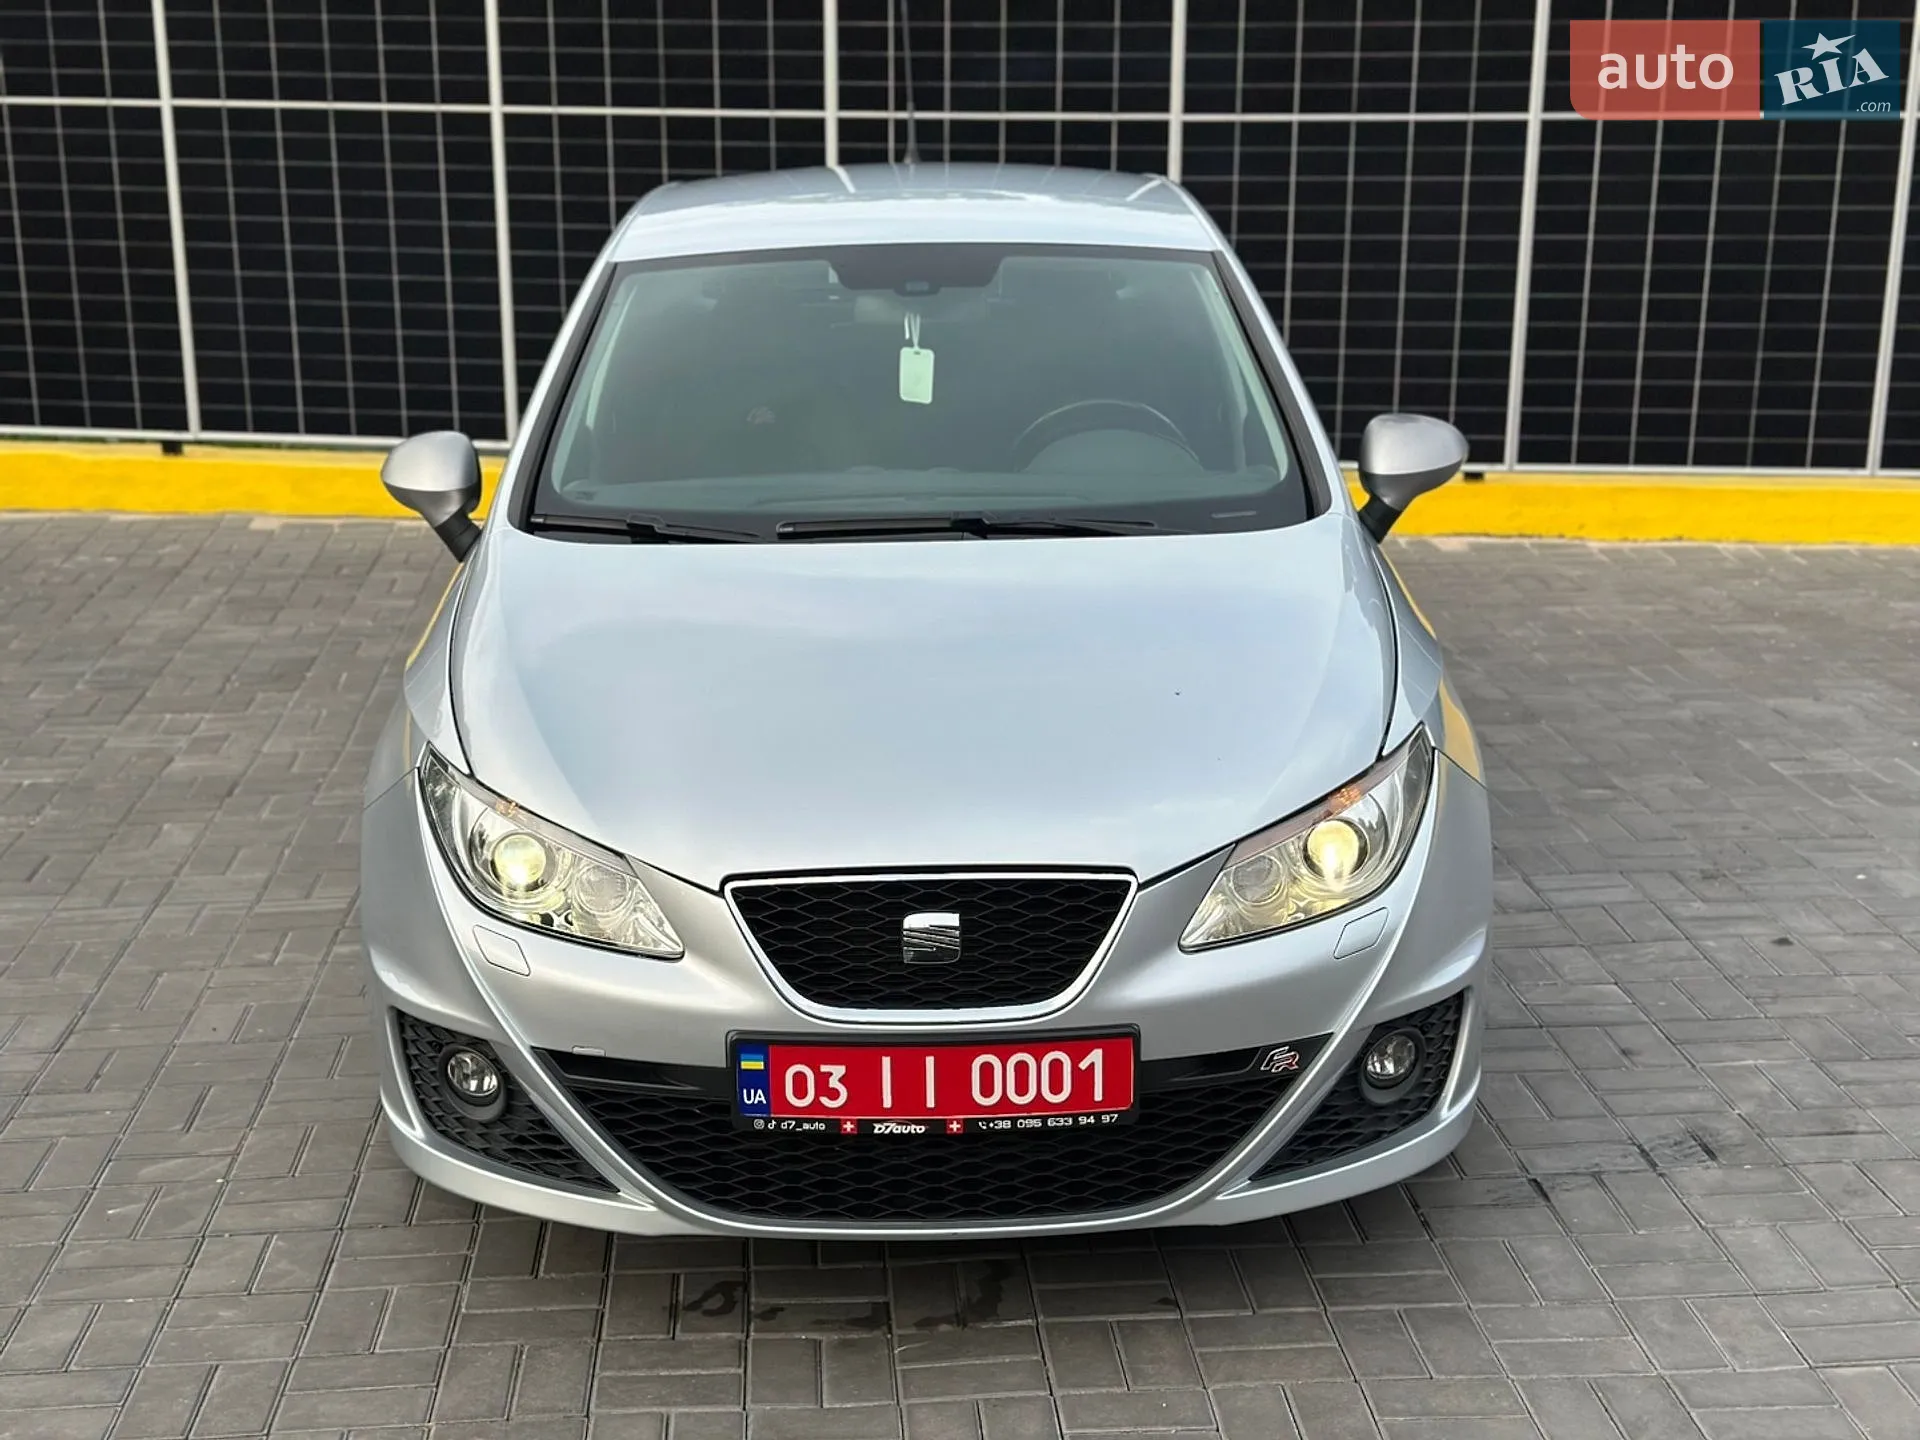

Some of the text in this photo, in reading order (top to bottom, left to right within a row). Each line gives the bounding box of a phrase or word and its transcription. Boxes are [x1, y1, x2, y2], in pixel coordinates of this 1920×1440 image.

[784, 1063, 848, 1109] 03
[971, 1048, 1104, 1105] 0001
[742, 1088, 767, 1105] UA
[780, 1120, 826, 1132] d7_auto
[989, 1113, 1119, 1130] +38 095 633 94 97
